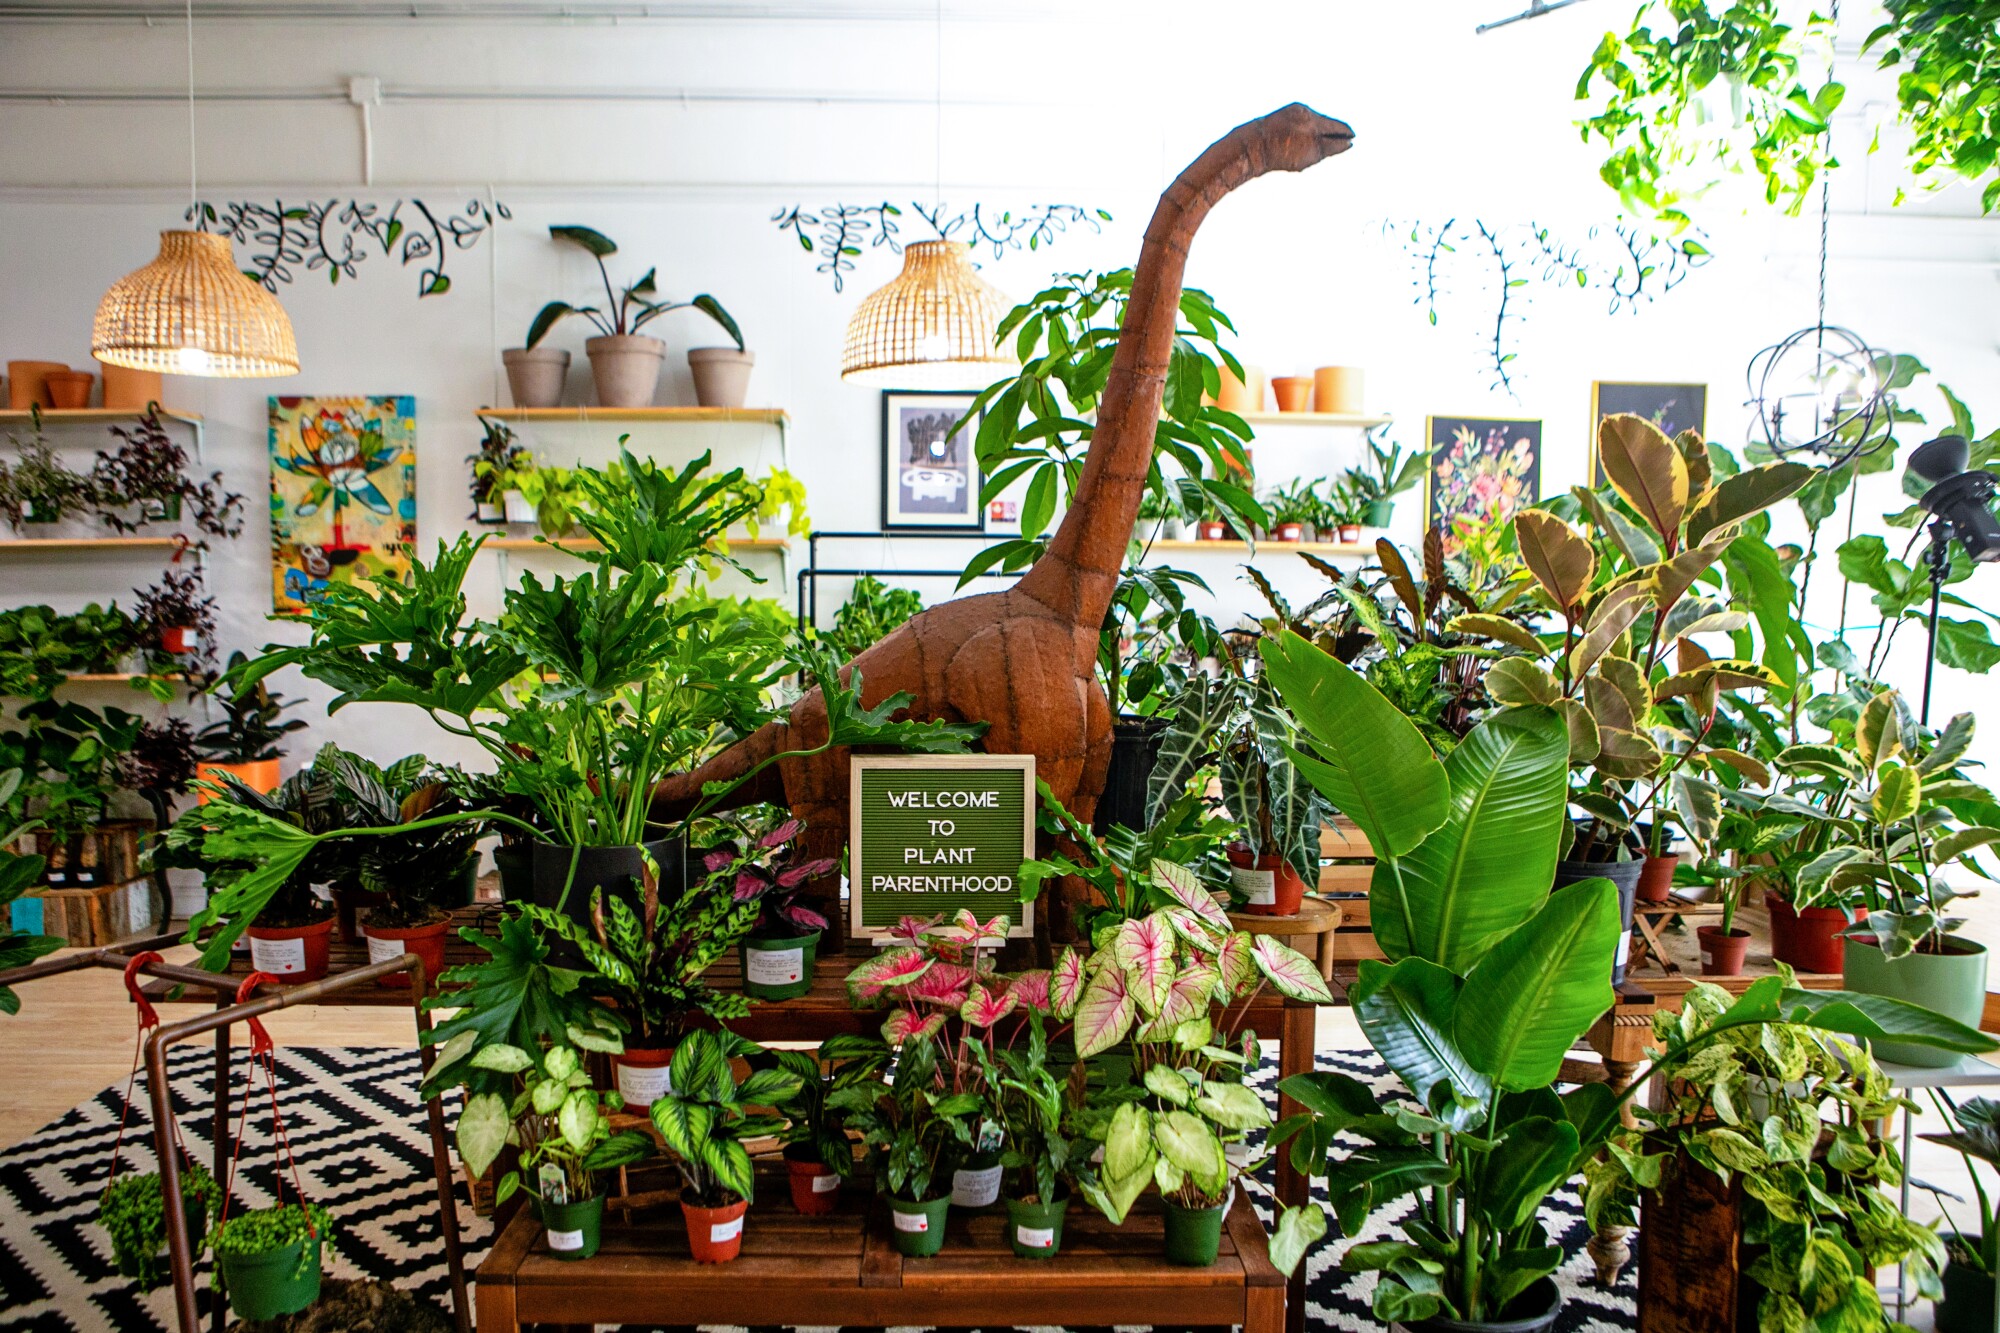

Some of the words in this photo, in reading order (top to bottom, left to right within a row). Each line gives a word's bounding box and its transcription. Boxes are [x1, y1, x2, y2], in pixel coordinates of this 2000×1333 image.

[887, 790, 1000, 808] WELCOME
[927, 820, 955, 836] TO
[904, 847, 976, 864] PLANT
[872, 874, 1012, 893] PARENTHOOD
